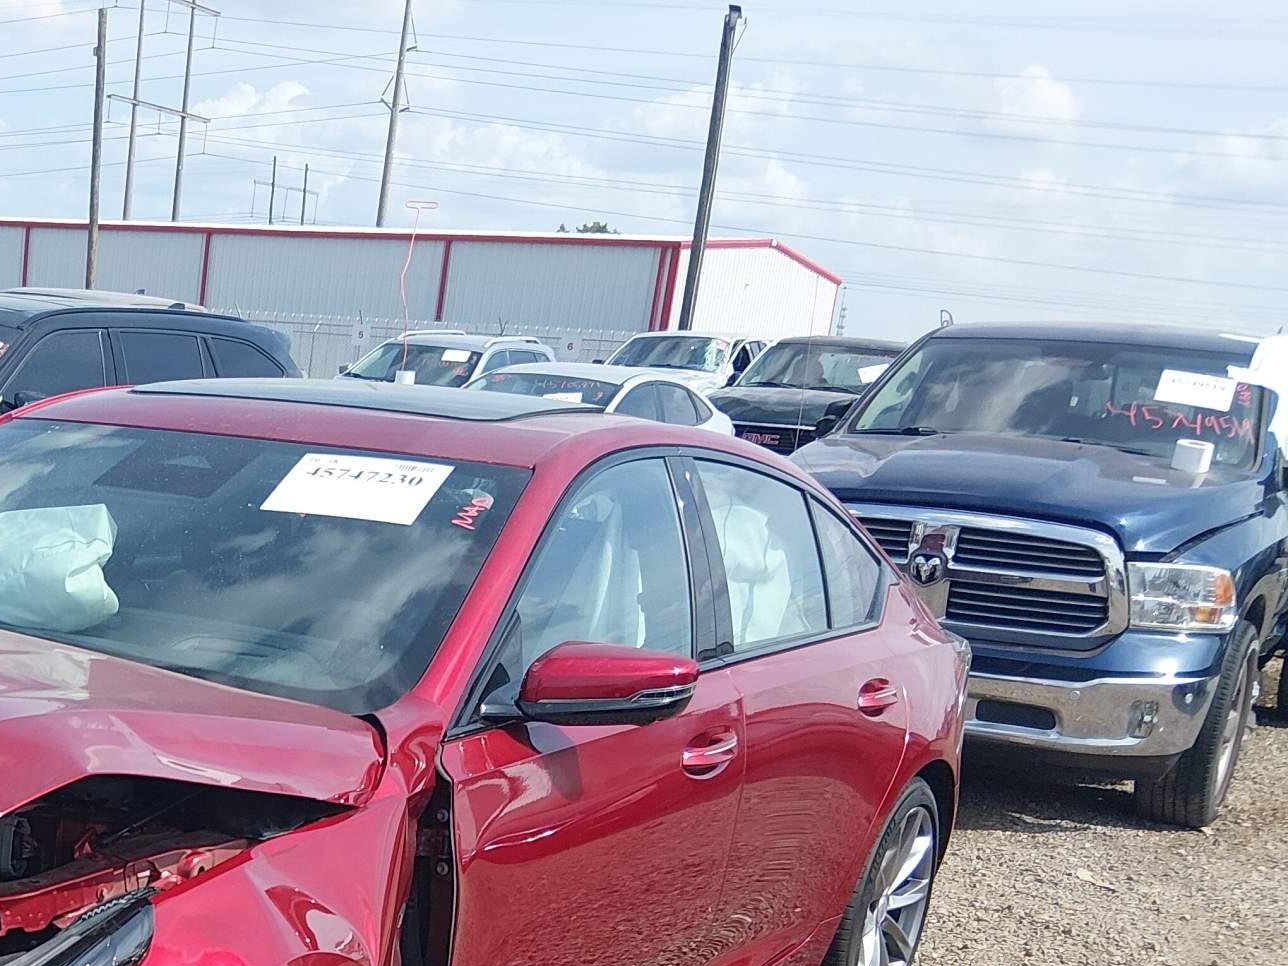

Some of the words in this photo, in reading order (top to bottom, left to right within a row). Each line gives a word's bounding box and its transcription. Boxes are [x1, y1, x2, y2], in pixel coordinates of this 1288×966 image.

[567, 342, 574, 351] 6
[742, 431, 781, 446] GMC
[305, 465, 425, 488] 45747230
